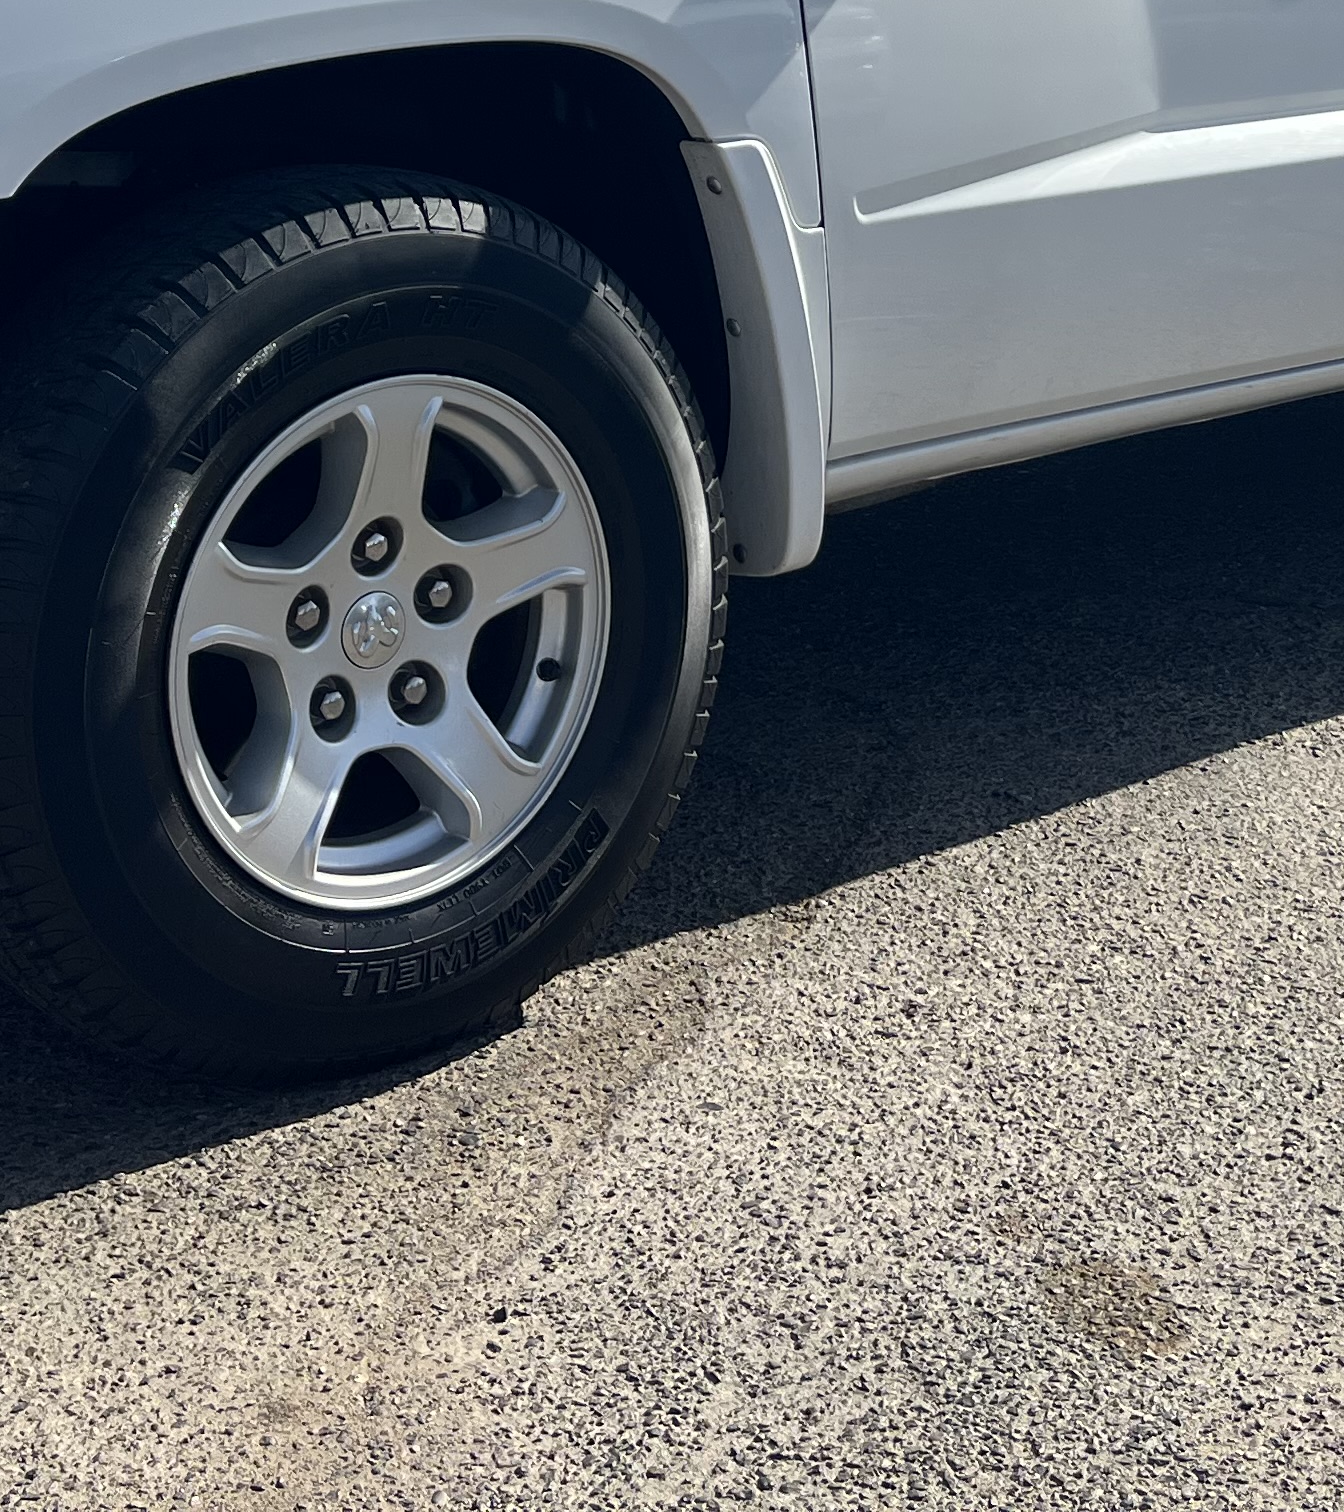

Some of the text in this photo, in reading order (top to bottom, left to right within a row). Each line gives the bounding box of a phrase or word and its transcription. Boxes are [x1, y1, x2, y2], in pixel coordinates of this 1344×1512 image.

[178, 295, 499, 466] VALERA HT
[336, 808, 611, 997] PRIMEWELL
